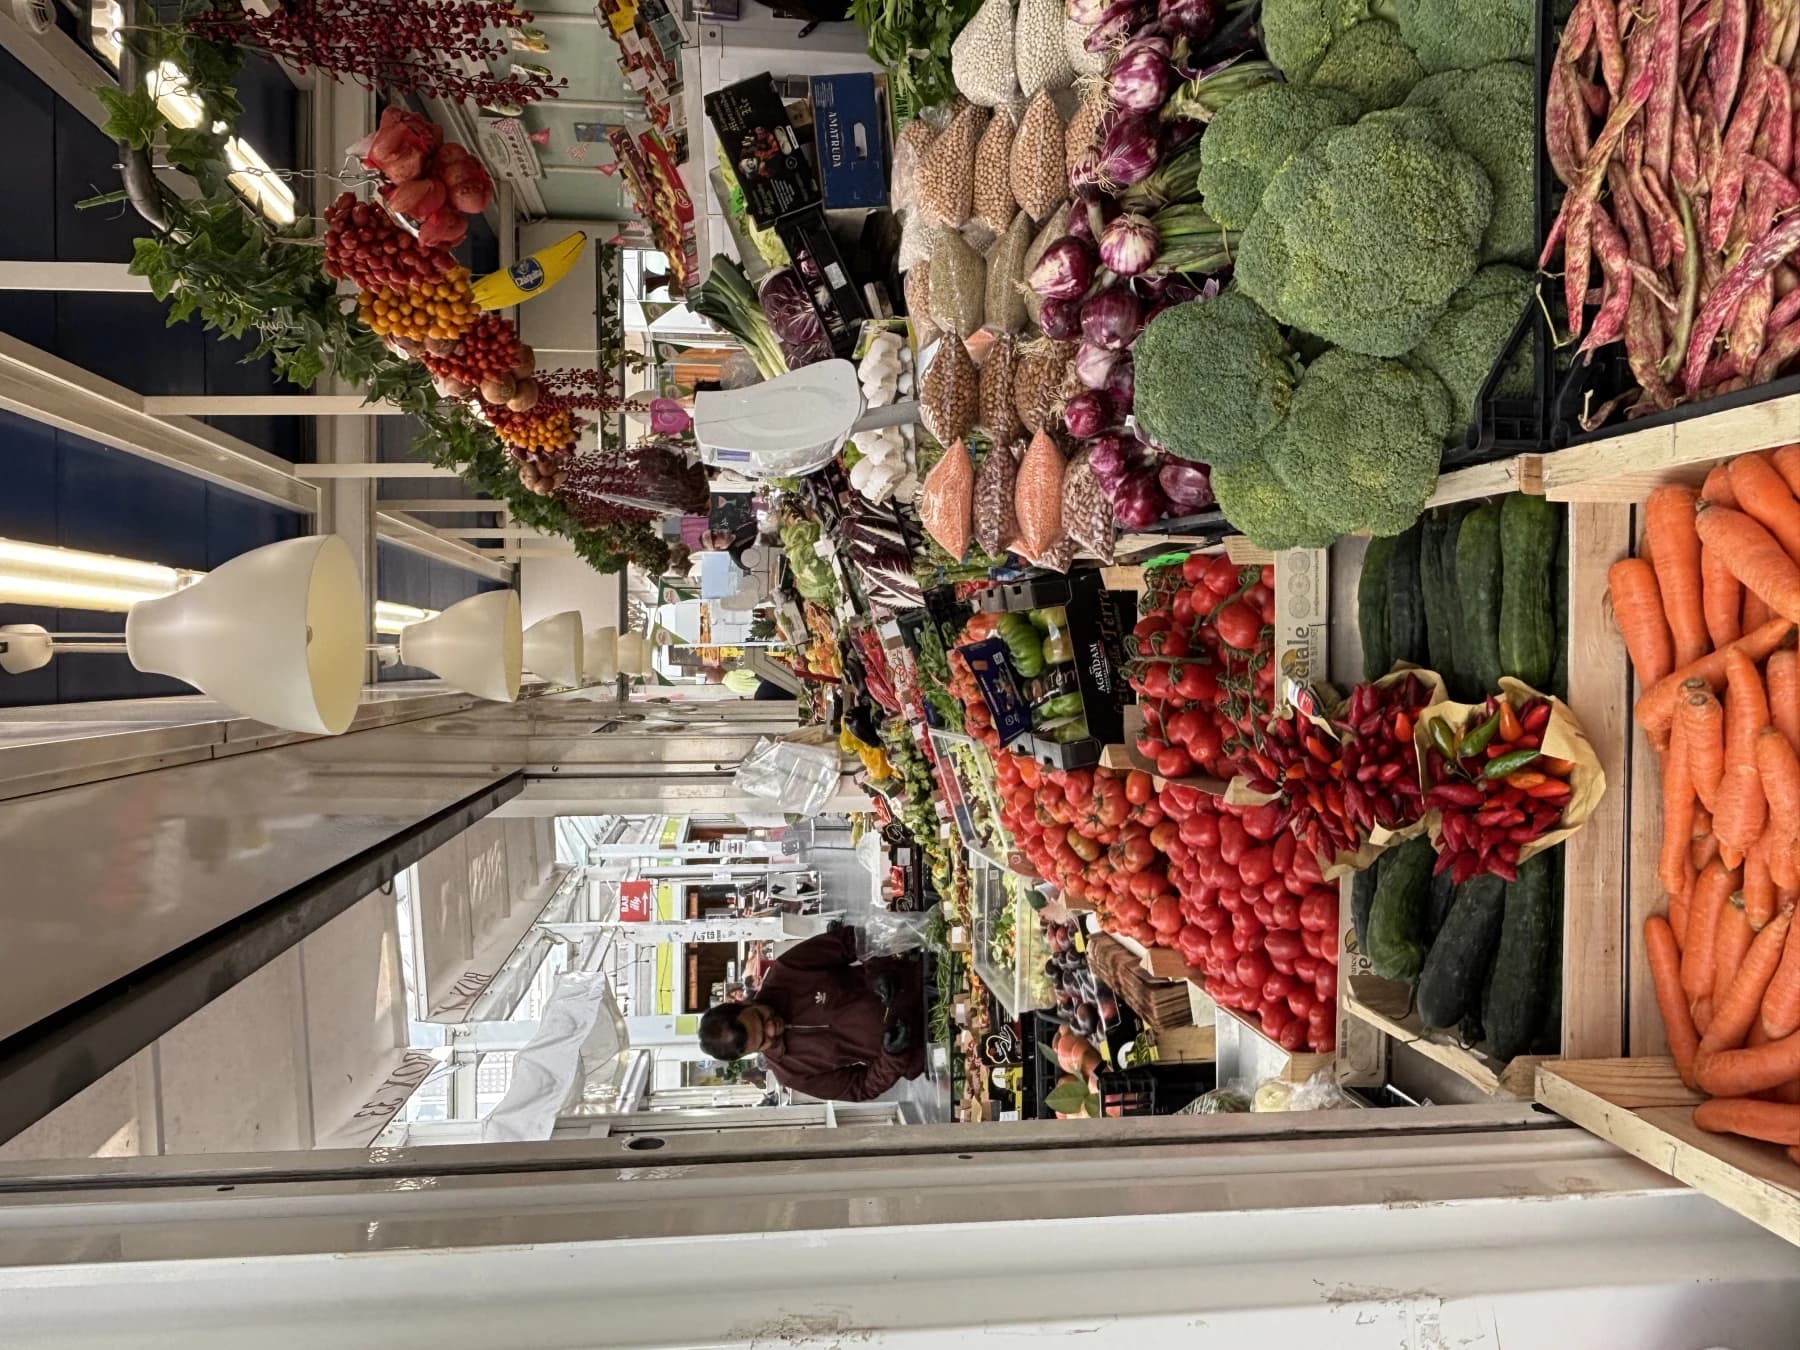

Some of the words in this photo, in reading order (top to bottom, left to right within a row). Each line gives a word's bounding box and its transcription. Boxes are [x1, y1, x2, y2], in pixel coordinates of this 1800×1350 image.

[1090, 642, 1106, 692] AGRIDAM
[1286, 626, 1309, 689] eciale
[621, 896, 629, 912] BAR
